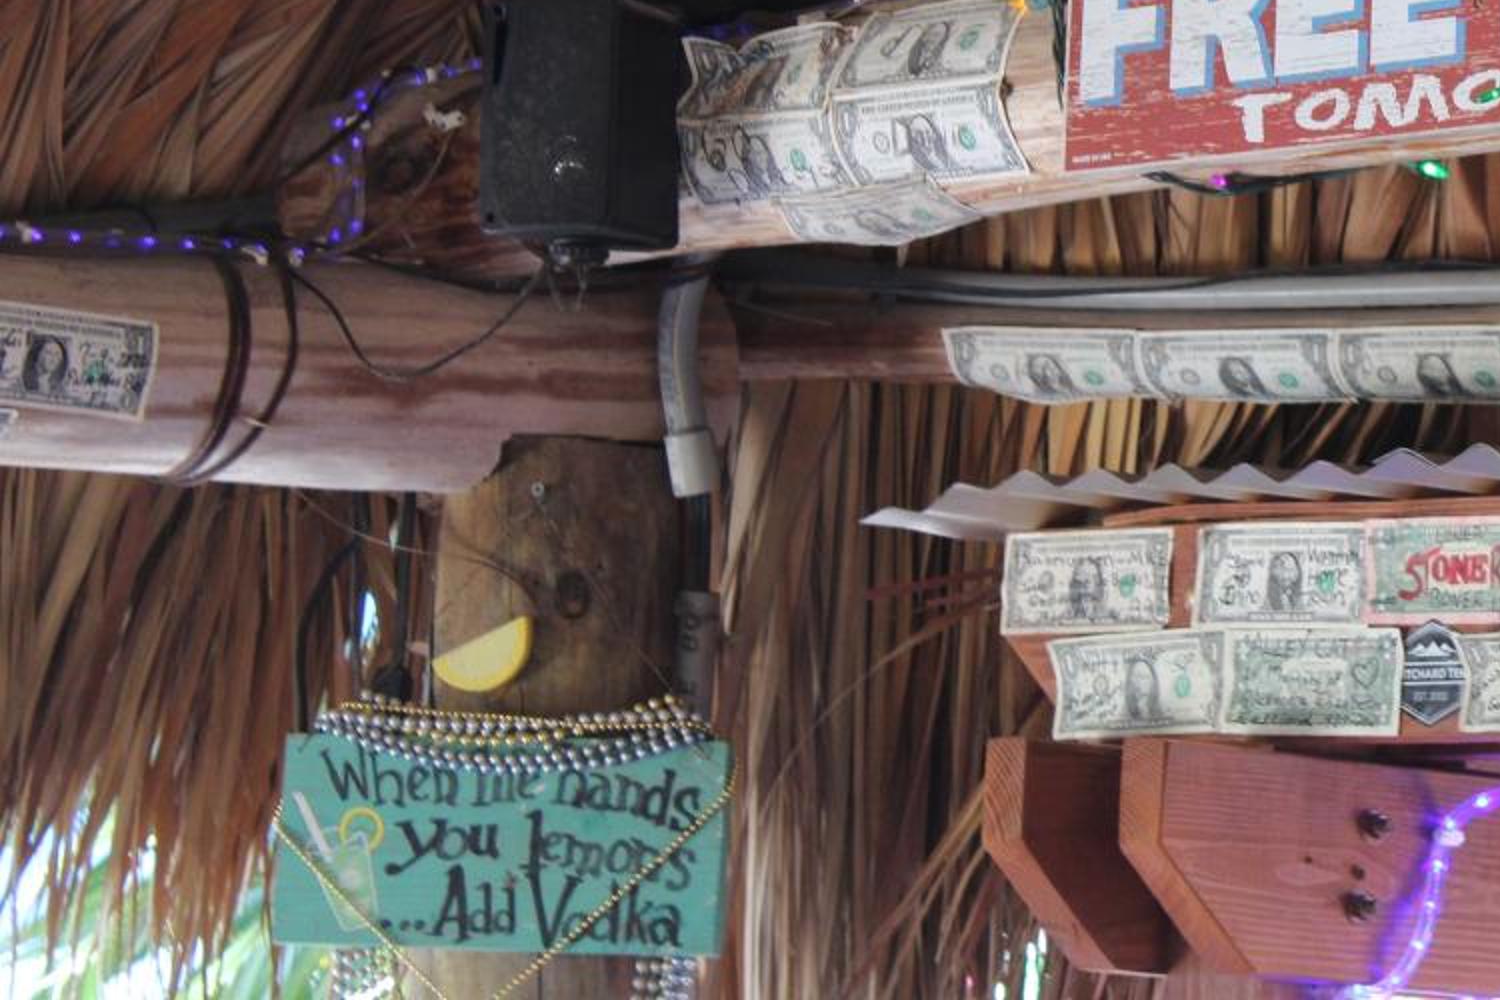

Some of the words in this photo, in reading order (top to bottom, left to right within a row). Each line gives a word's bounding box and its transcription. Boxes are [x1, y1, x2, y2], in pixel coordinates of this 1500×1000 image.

[385, 817, 500, 877] you
[519, 808, 697, 891] lemons
[519, 865, 683, 949] Vodka
